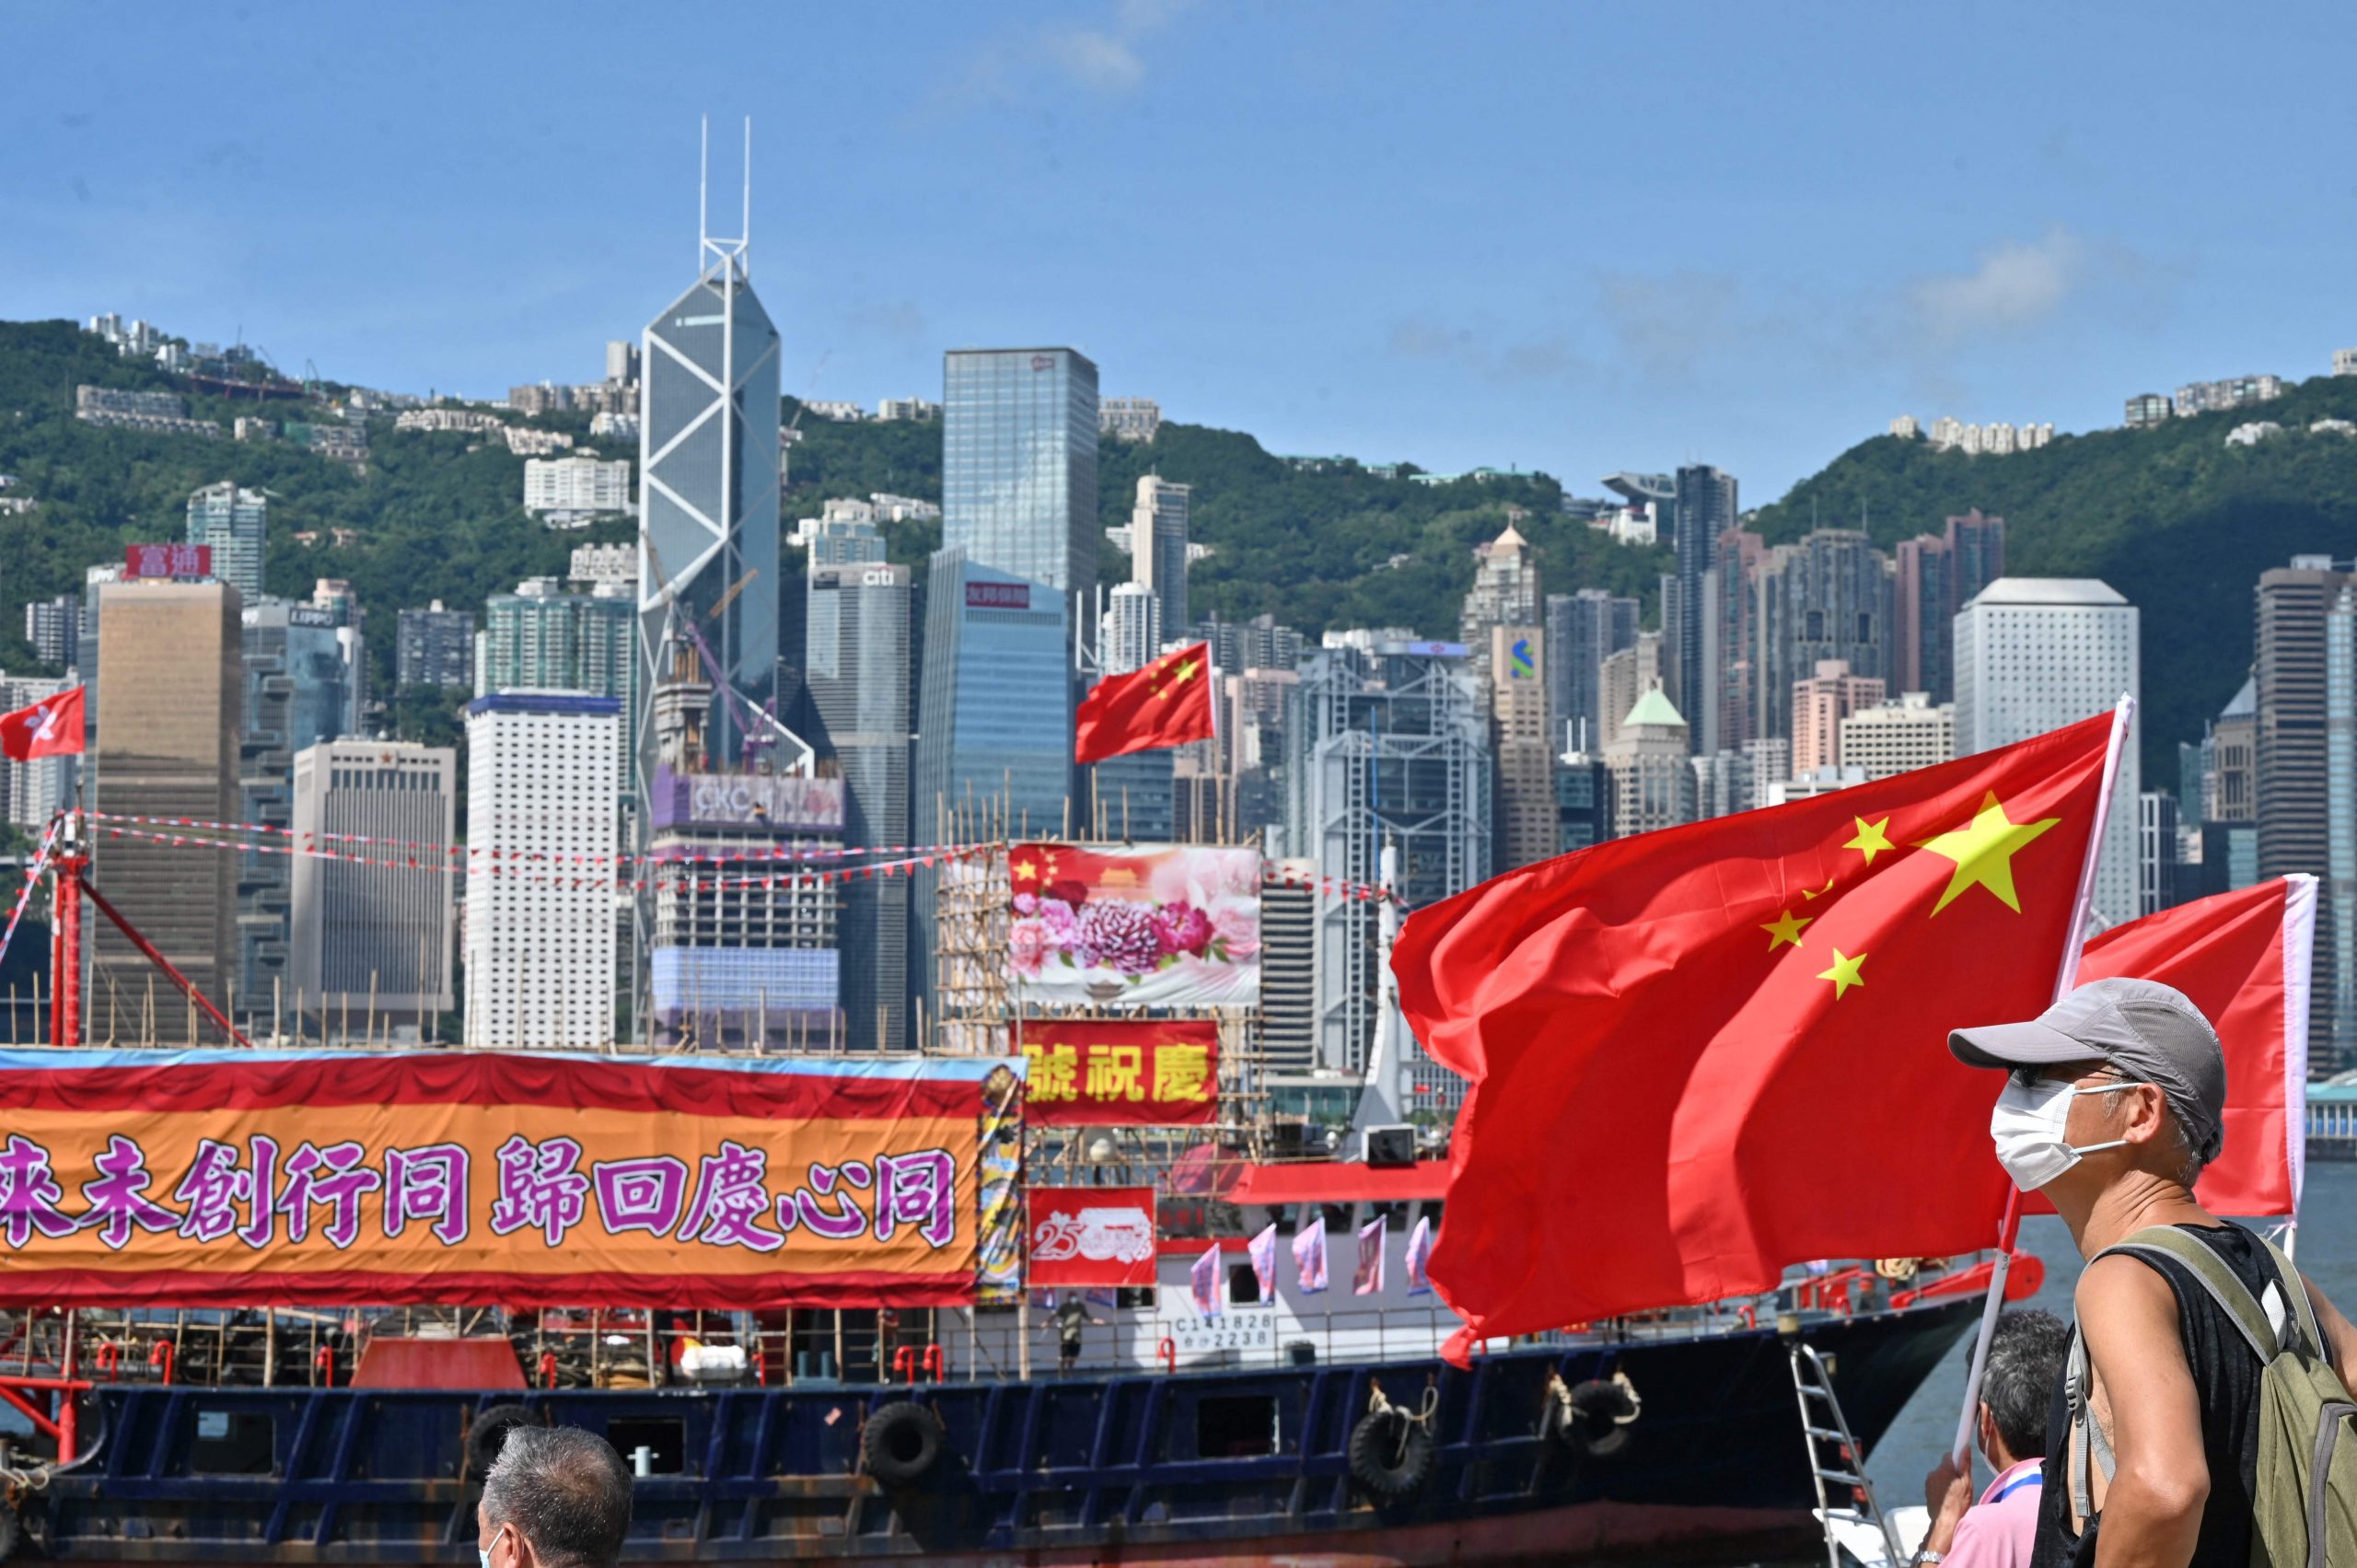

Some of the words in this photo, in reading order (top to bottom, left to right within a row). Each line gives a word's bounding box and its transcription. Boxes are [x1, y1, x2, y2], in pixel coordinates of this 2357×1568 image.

[863, 566, 895, 587] citi
[290, 610, 334, 627] LIPPO
[1029, 1217, 1086, 1260] 25
